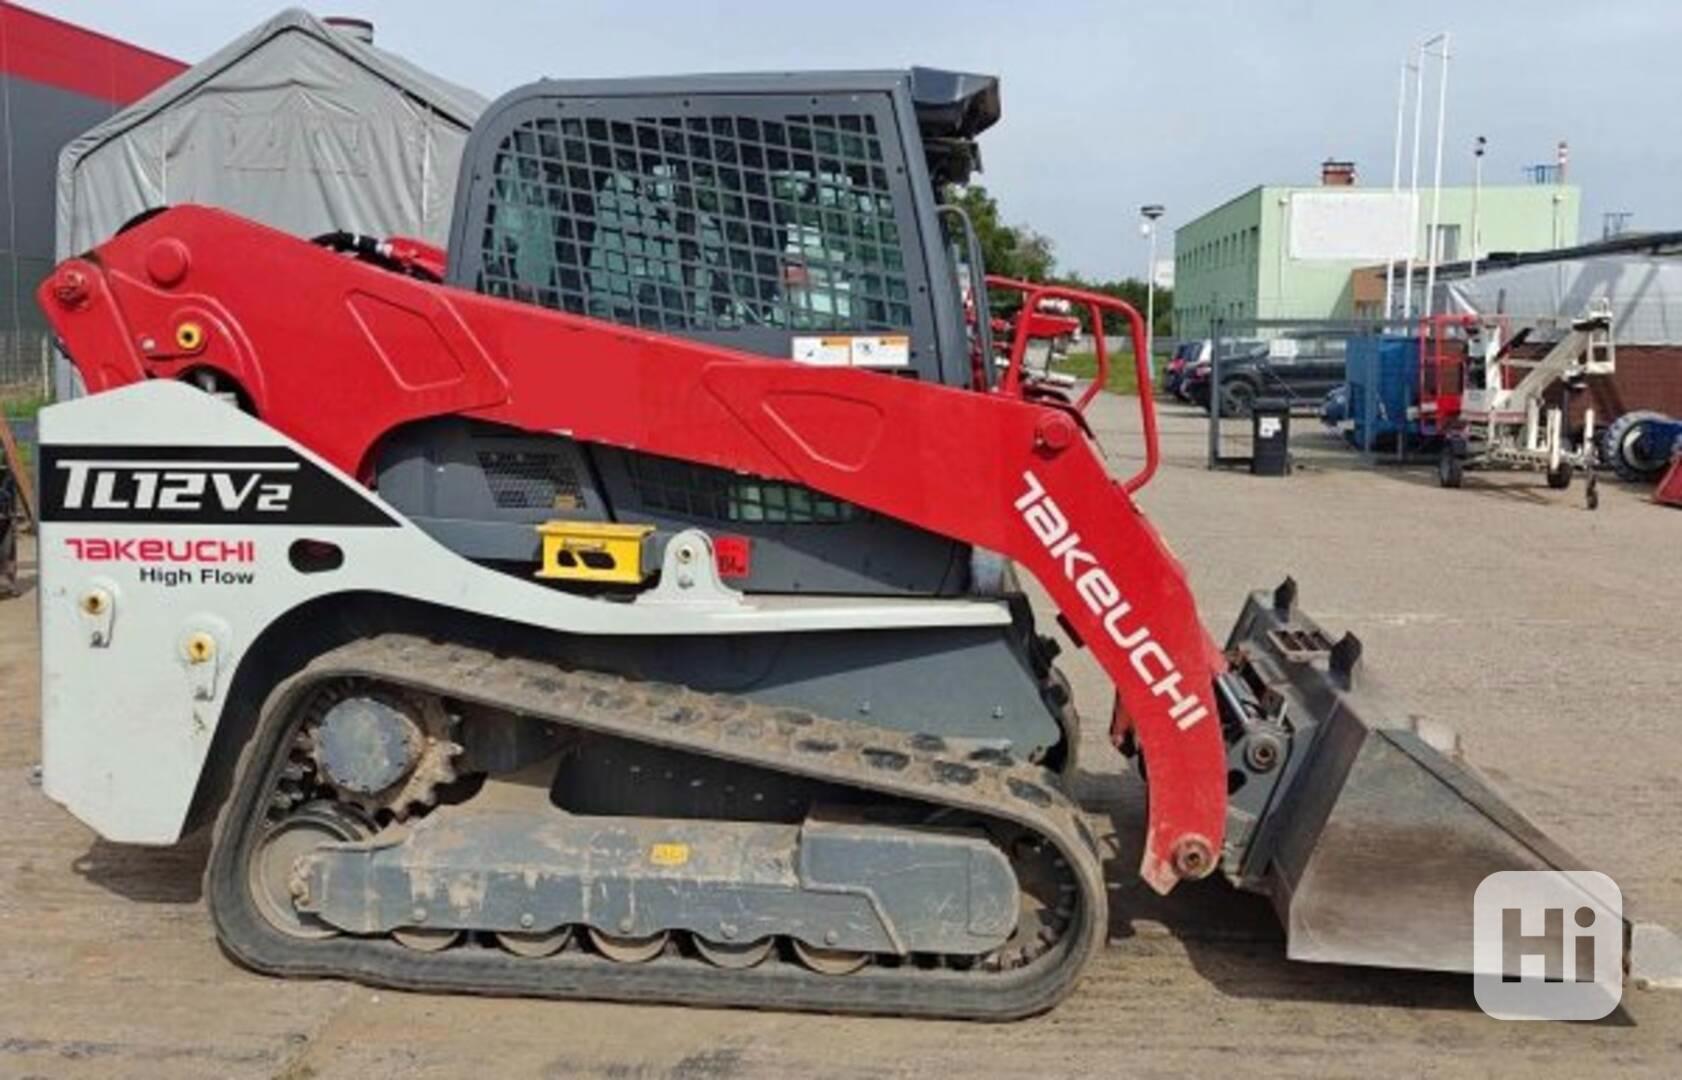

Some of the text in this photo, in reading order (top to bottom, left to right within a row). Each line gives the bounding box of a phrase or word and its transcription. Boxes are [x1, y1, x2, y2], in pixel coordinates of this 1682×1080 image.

[56, 460, 300, 511] TL12V2
[140, 568, 254, 586] High Flow
